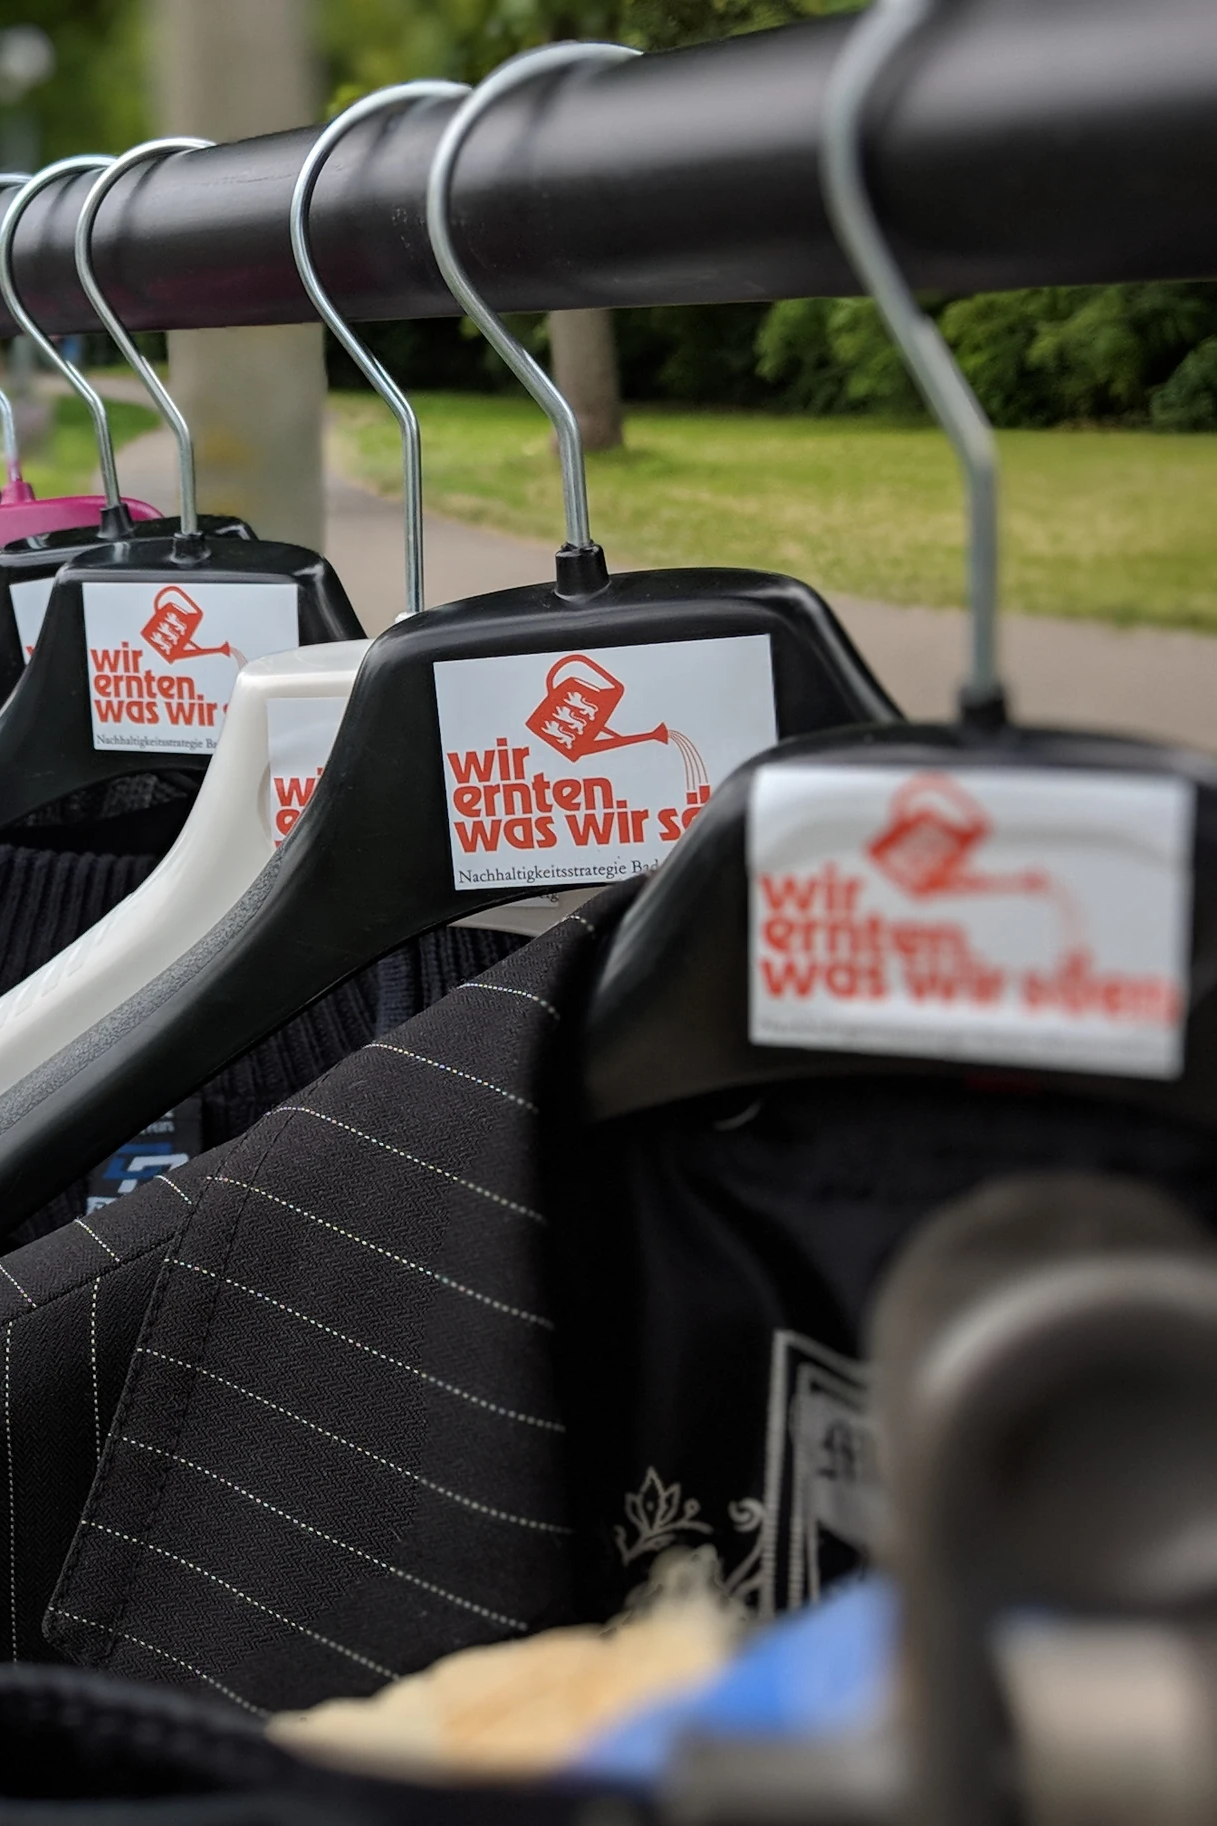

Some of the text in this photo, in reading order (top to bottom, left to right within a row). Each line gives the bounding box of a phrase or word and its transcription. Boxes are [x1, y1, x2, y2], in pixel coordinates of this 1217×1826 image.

[91, 642, 143, 674] wir
[94, 695, 217, 727] was wir
[96, 734, 203, 750] Nachhaltigkeitsstrategie
[447, 738, 529, 783] wir
[454, 816, 557, 853] was
[565, 800, 649, 846] wir
[459, 862, 627, 884] Nachhaltigkeitsstrategie
[760, 860, 864, 911] wir
